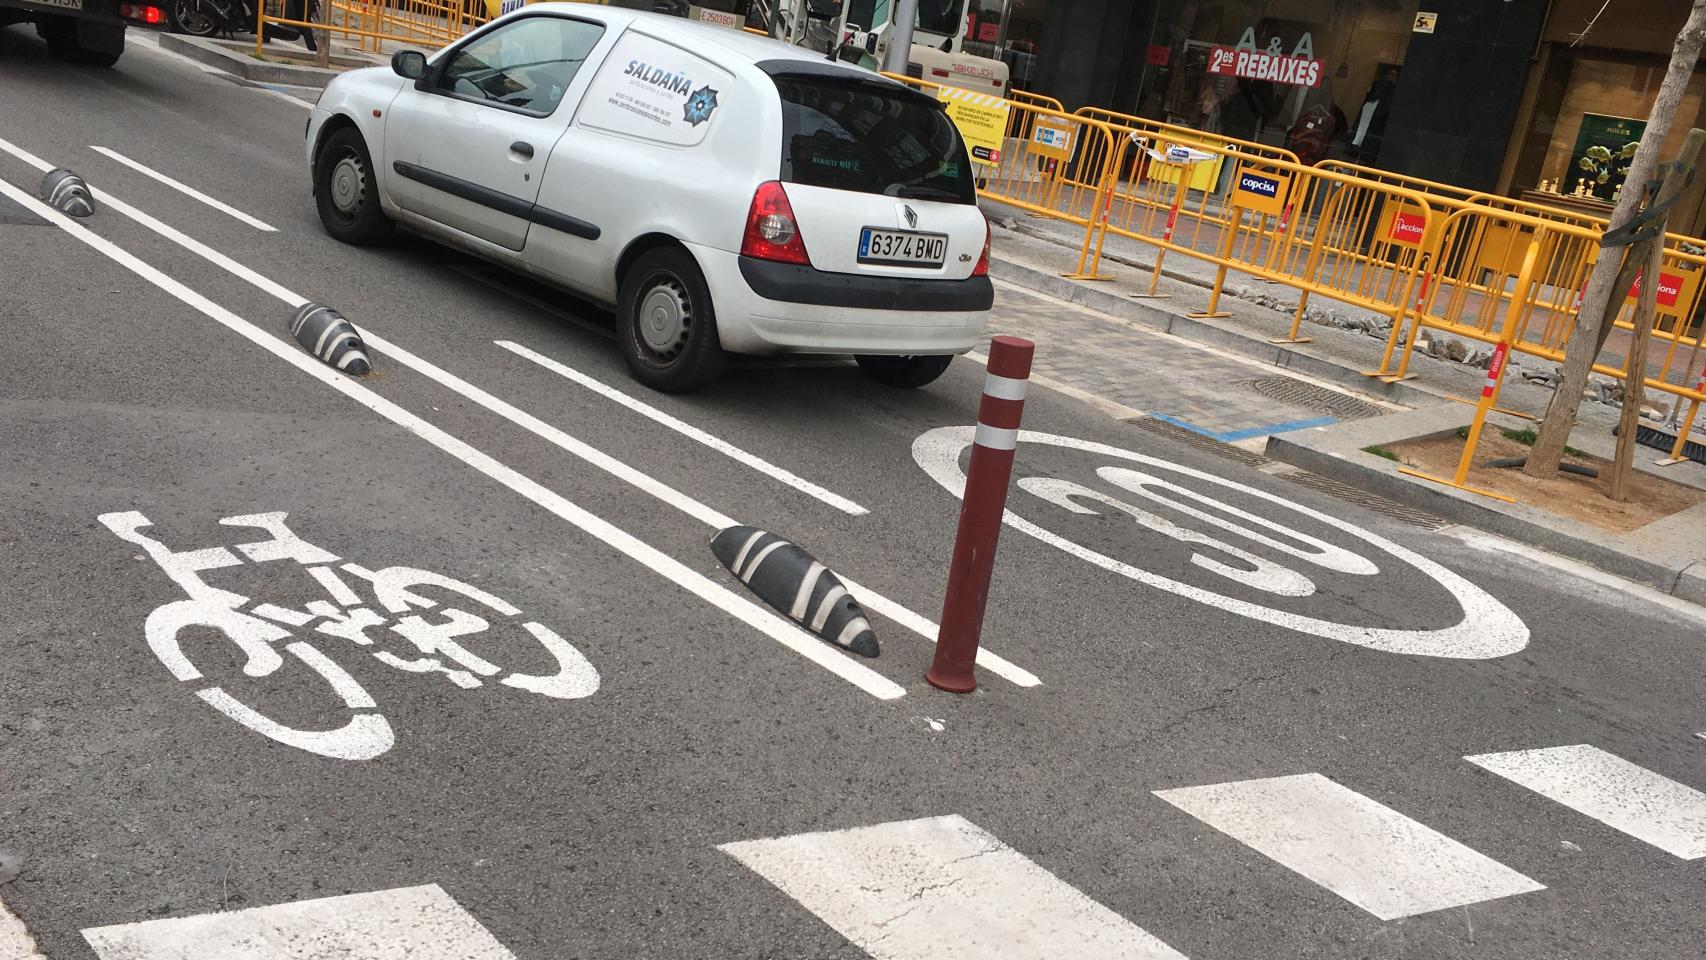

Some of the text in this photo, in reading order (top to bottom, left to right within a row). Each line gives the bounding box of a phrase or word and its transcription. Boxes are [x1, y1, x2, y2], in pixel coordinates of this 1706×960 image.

[1235, 26, 1314, 61] A & A
[624, 60, 692, 97] SALDAÑA
[1236, 52, 1319, 87] REBAIXES
[1606, 127, 1630, 136] ROLEX
[1400, 223, 1424, 234] accion
[871, 234, 943, 260] 6374 BMD
[1017, 466, 1379, 598] 30
